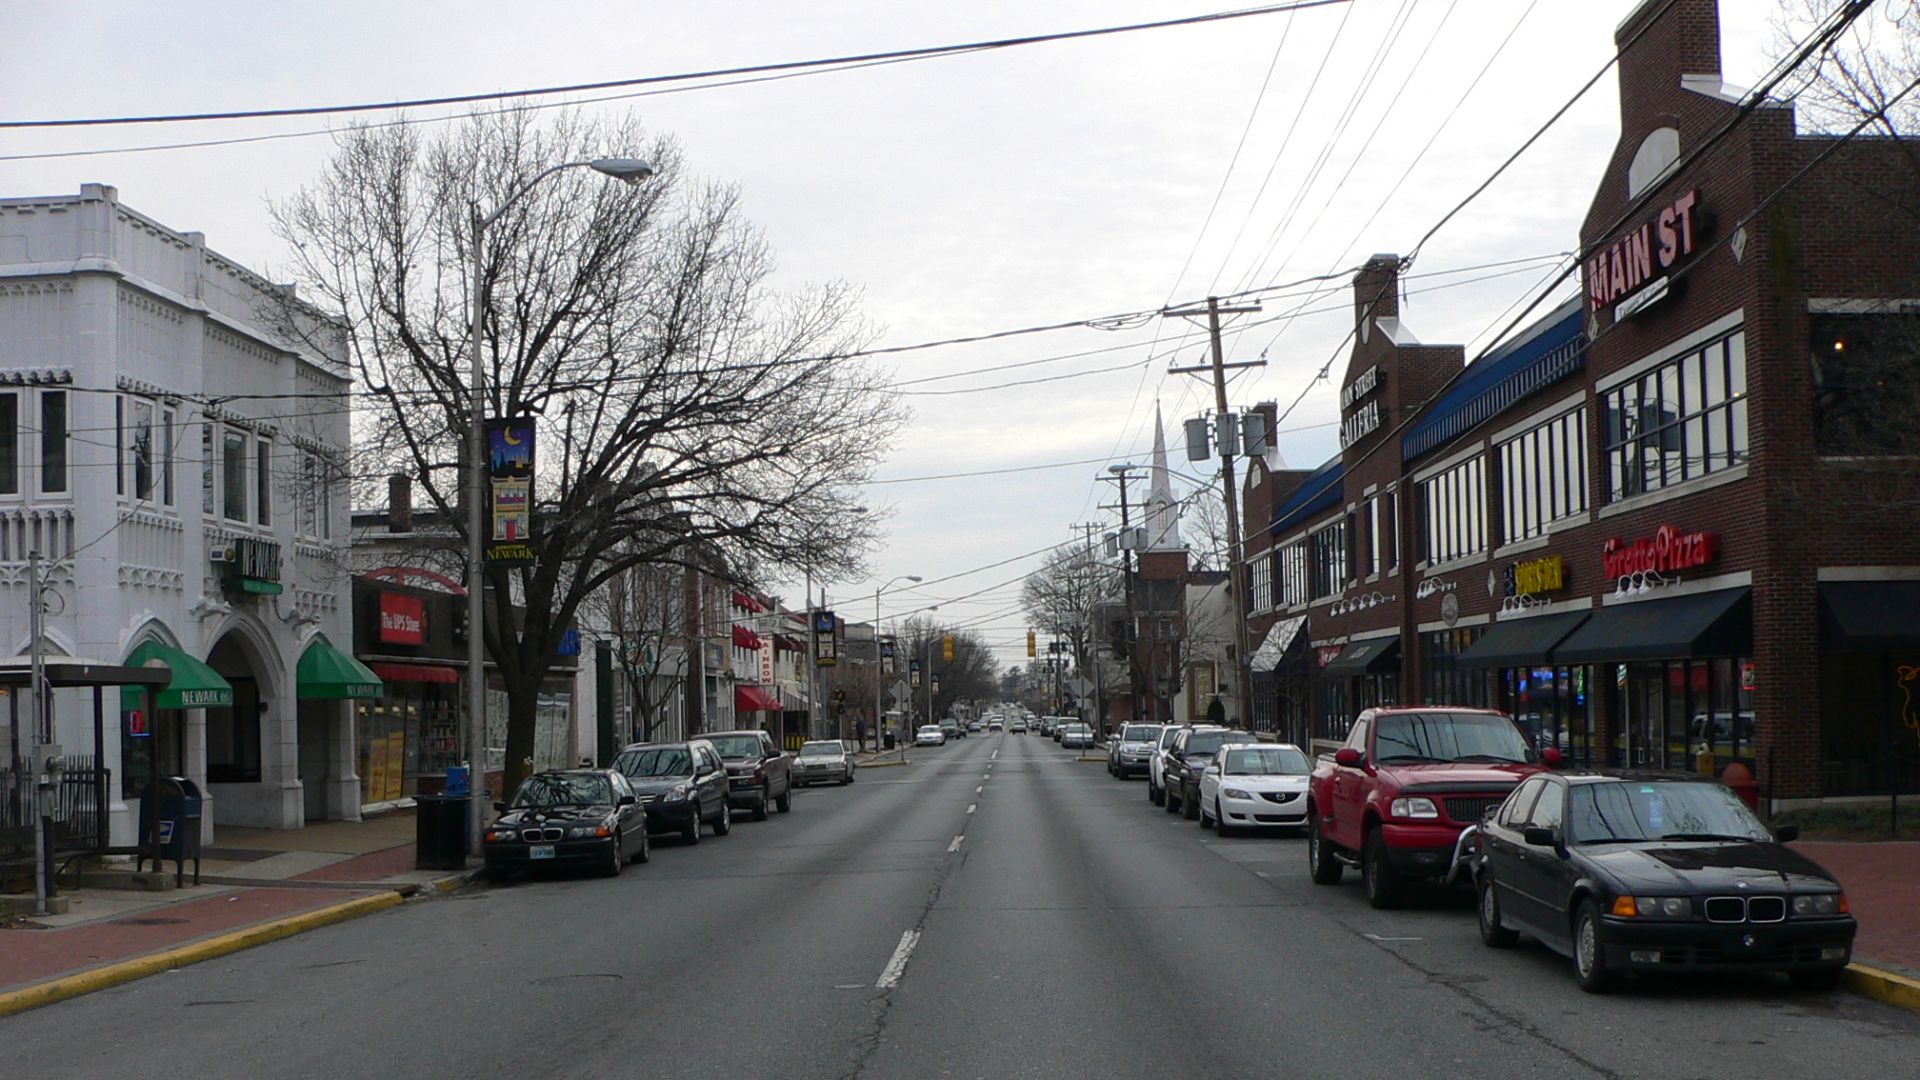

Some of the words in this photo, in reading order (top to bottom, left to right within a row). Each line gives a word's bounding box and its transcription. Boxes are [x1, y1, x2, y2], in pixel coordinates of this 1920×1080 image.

[1589, 223, 1651, 312] MAIN
[1658, 190, 1694, 267] ST
[487, 548, 534, 560] NEWARK
[1656, 525, 1704, 572] Pizza
[393, 613, 405, 631] UPS
[182, 690, 218, 704] NEWARK
